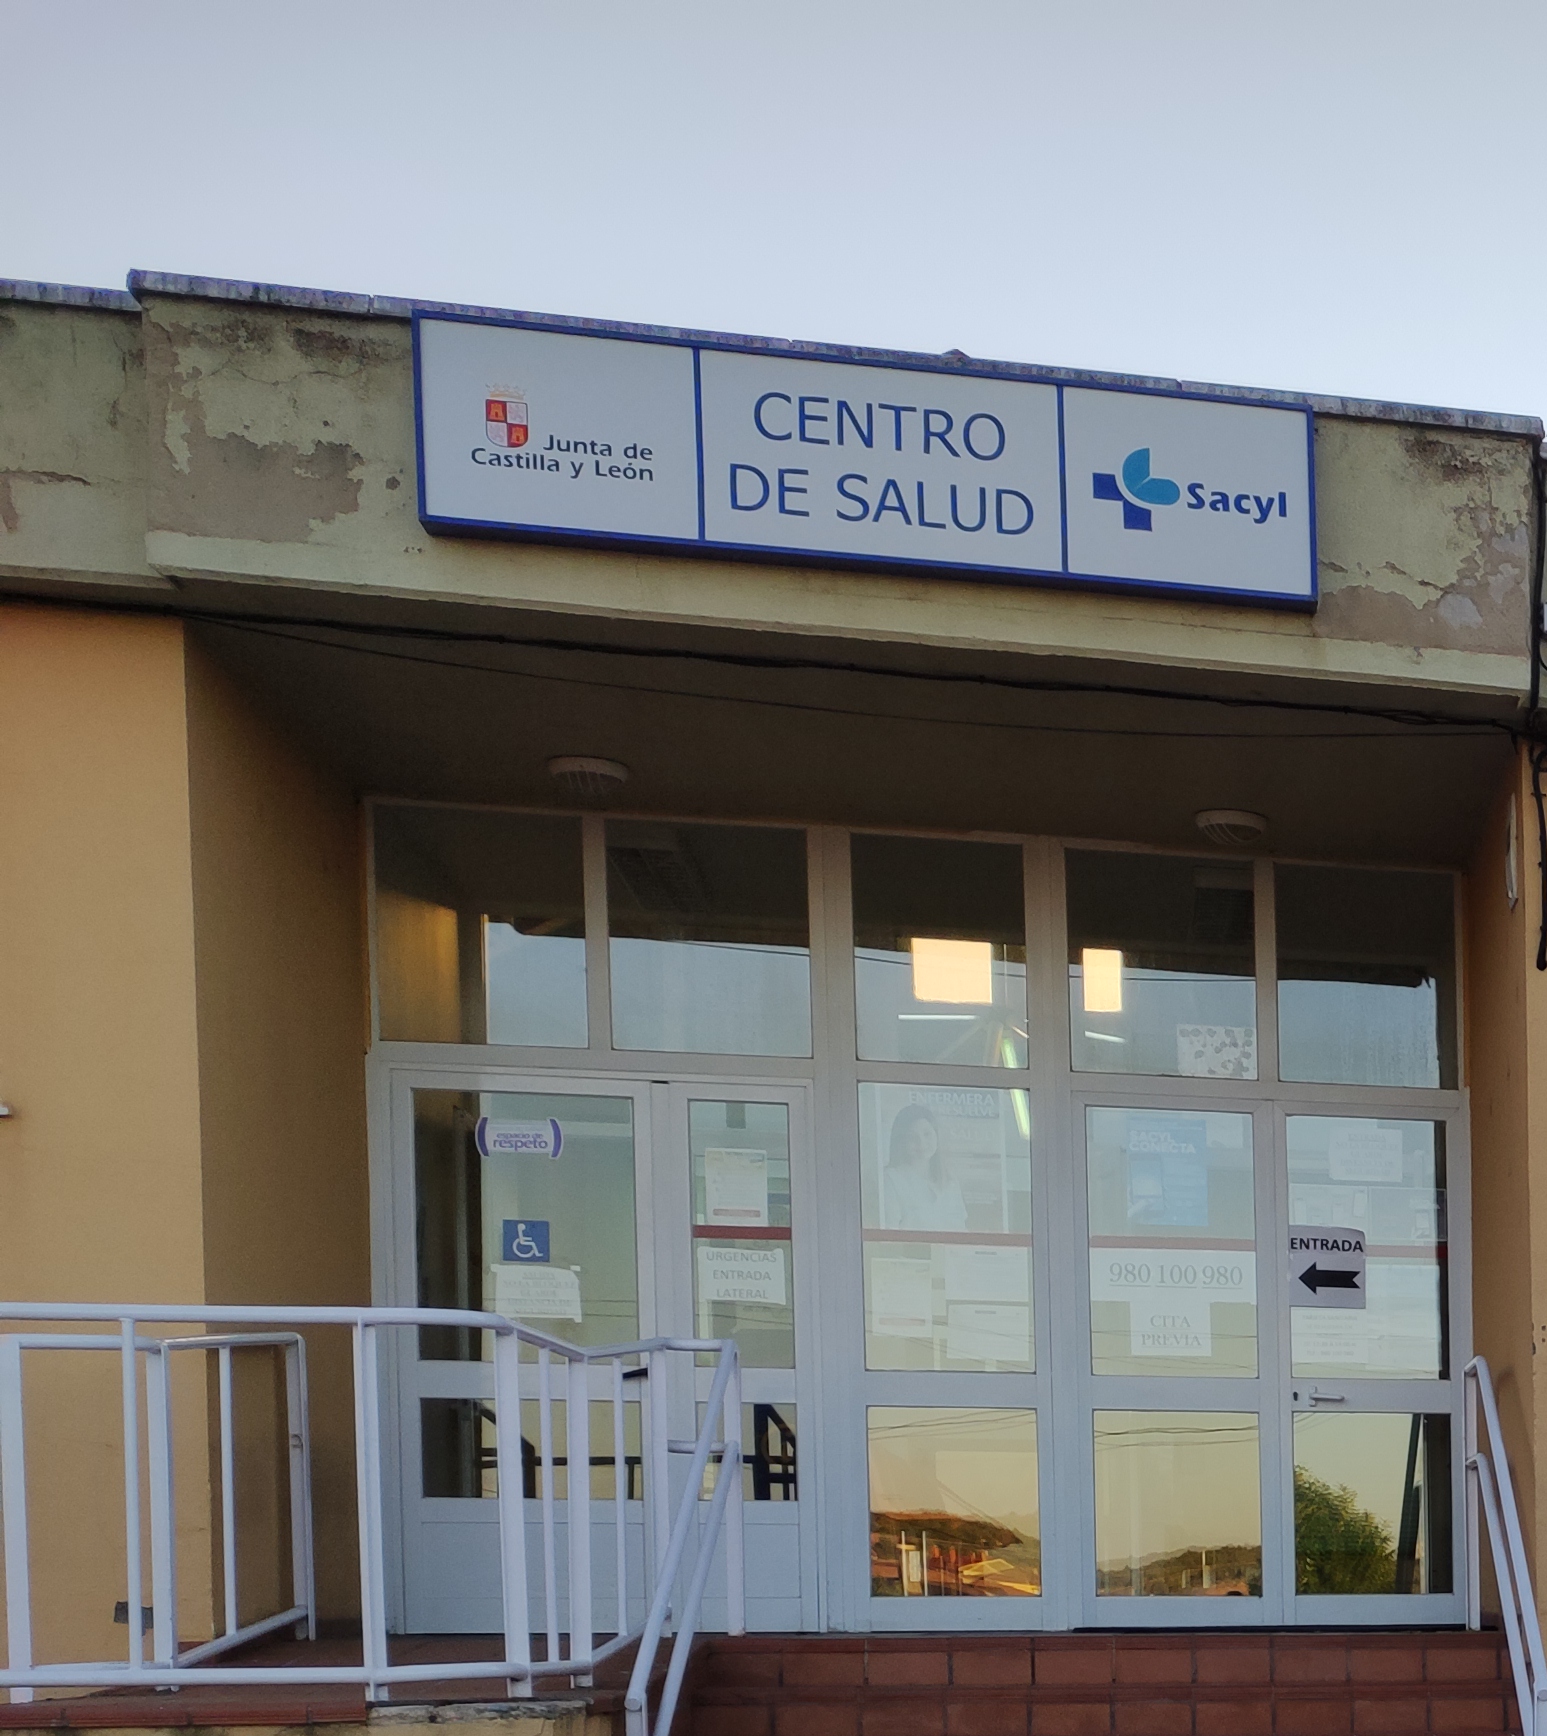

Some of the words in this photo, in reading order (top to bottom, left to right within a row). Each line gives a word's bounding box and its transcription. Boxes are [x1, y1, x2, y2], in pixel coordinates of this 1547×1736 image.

[754, 391, 1006, 461] CENTRO
[543, 434, 612, 457] Junta
[623, 443, 653, 461] de
[471, 447, 560, 472] Castilla
[570, 460, 584, 479] y
[595, 460, 654, 481] León
[730, 463, 810, 517] DE
[836, 473, 1035, 536] SALUD
[1186, 482, 1287, 525] Sacyl
[908, 1091, 995, 1106] ENFERMERA
[1129, 1130, 1175, 1143] SACYL
[493, 1139, 548, 1151] respeto
[1129, 1141, 1197, 1154] CONECTA
[1290, 1236, 1364, 1254] ENTRADA
[705, 1250, 777, 1263] URGENCIAS
[713, 1269, 772, 1281] ENTRADA
[1109, 1262, 1151, 1284] 980
[1157, 1263, 1198, 1285] 100
[1201, 1265, 1243, 1286] 980
[716, 1288, 768, 1300] LATERAL
[1150, 1314, 1192, 1328] CITA
[1141, 1333, 1202, 1347] PREVIA
